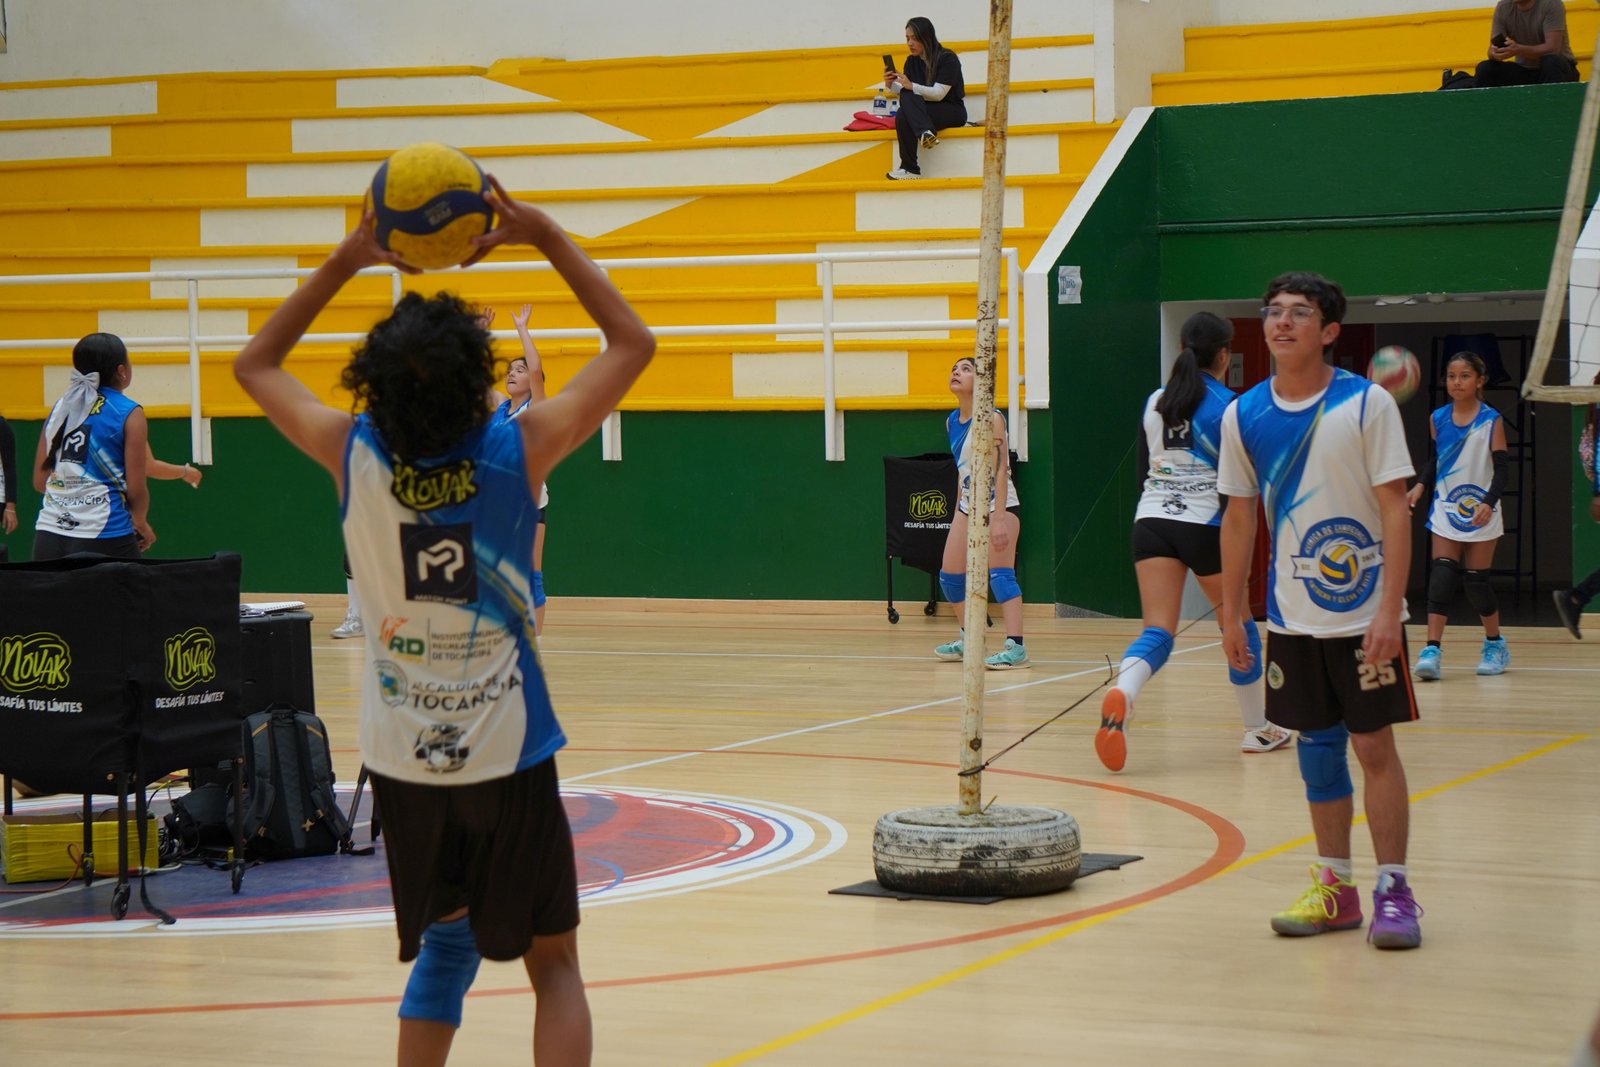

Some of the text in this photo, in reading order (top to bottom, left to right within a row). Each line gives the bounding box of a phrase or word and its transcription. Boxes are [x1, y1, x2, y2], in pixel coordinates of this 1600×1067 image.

[395, 462, 476, 506] NOVAK
[911, 494, 946, 516] NOVAK
[1, 640, 67, 685] NOVAK
[167, 639, 213, 680] NOVAK
[1357, 661, 1397, 691] 25
[0, 694, 83, 713] SAFÍA TUS LÍMITES
[155, 693, 186, 709] DESAFÍA
[187, 694, 201, 706] TUS
